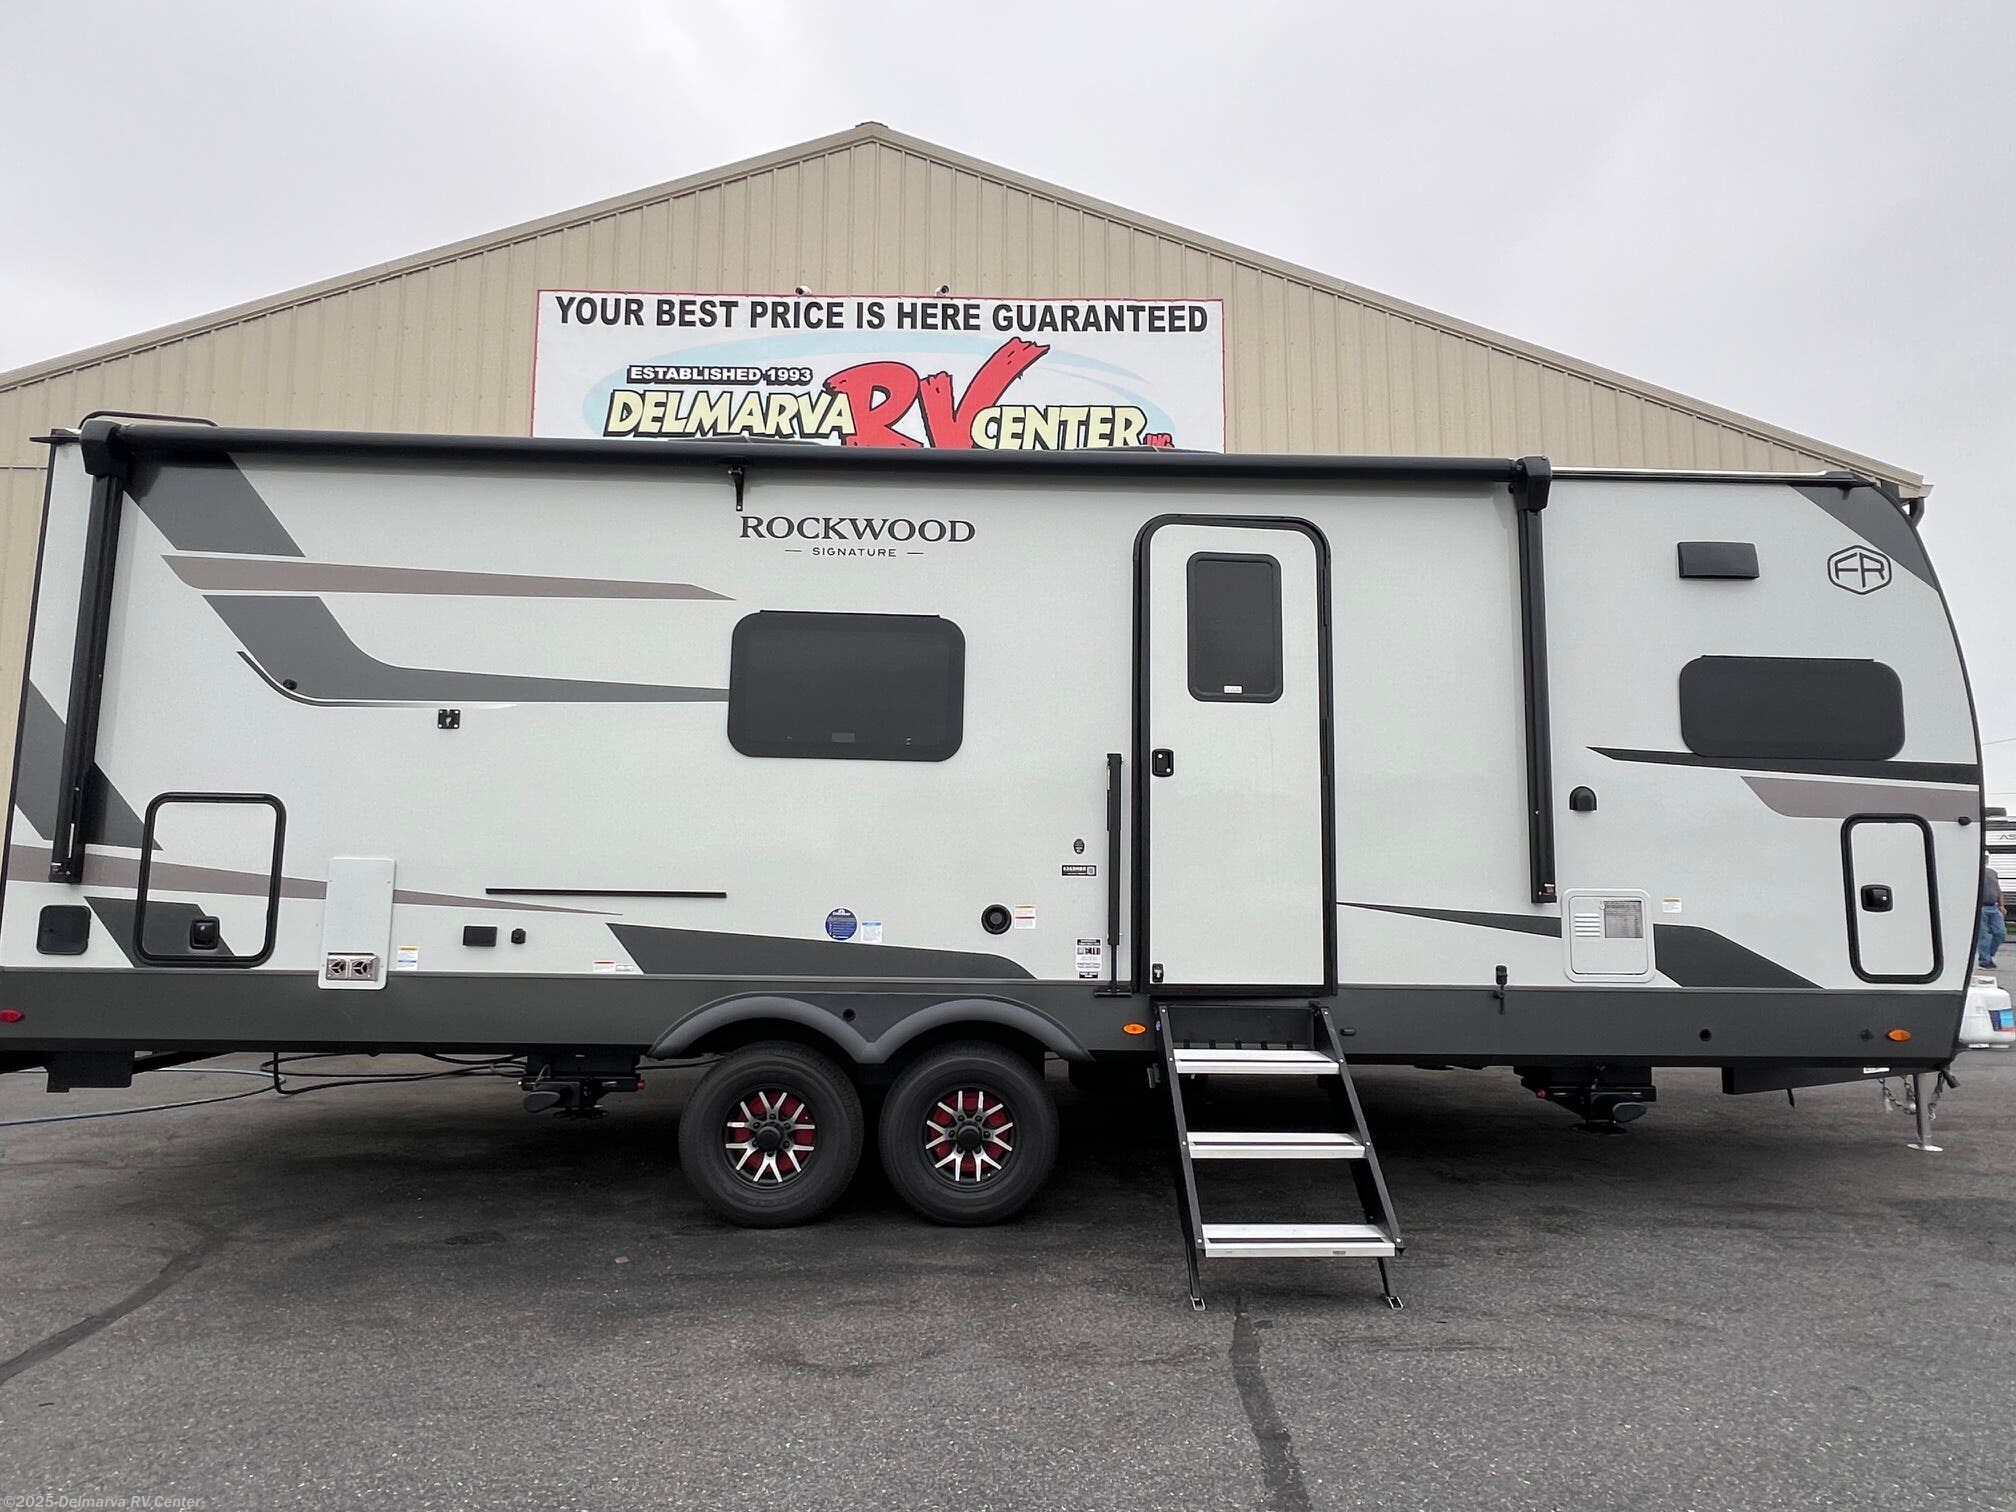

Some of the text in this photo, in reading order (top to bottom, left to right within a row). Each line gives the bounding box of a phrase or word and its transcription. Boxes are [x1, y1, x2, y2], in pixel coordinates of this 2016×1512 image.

[555, 296, 1208, 332] YOUR BEST PRICE IS HERE GUARANTEED
[629, 366, 812, 383] ESTABLISHED 1993
[604, 388, 857, 438] DELMARVA
[824, 336, 1051, 449] RV
[970, 405, 1147, 450] CENTER
[740, 516, 976, 543] ROCKWOOD
[812, 547, 897, 558] SIGNATURE
[1834, 551, 1886, 588] FR
